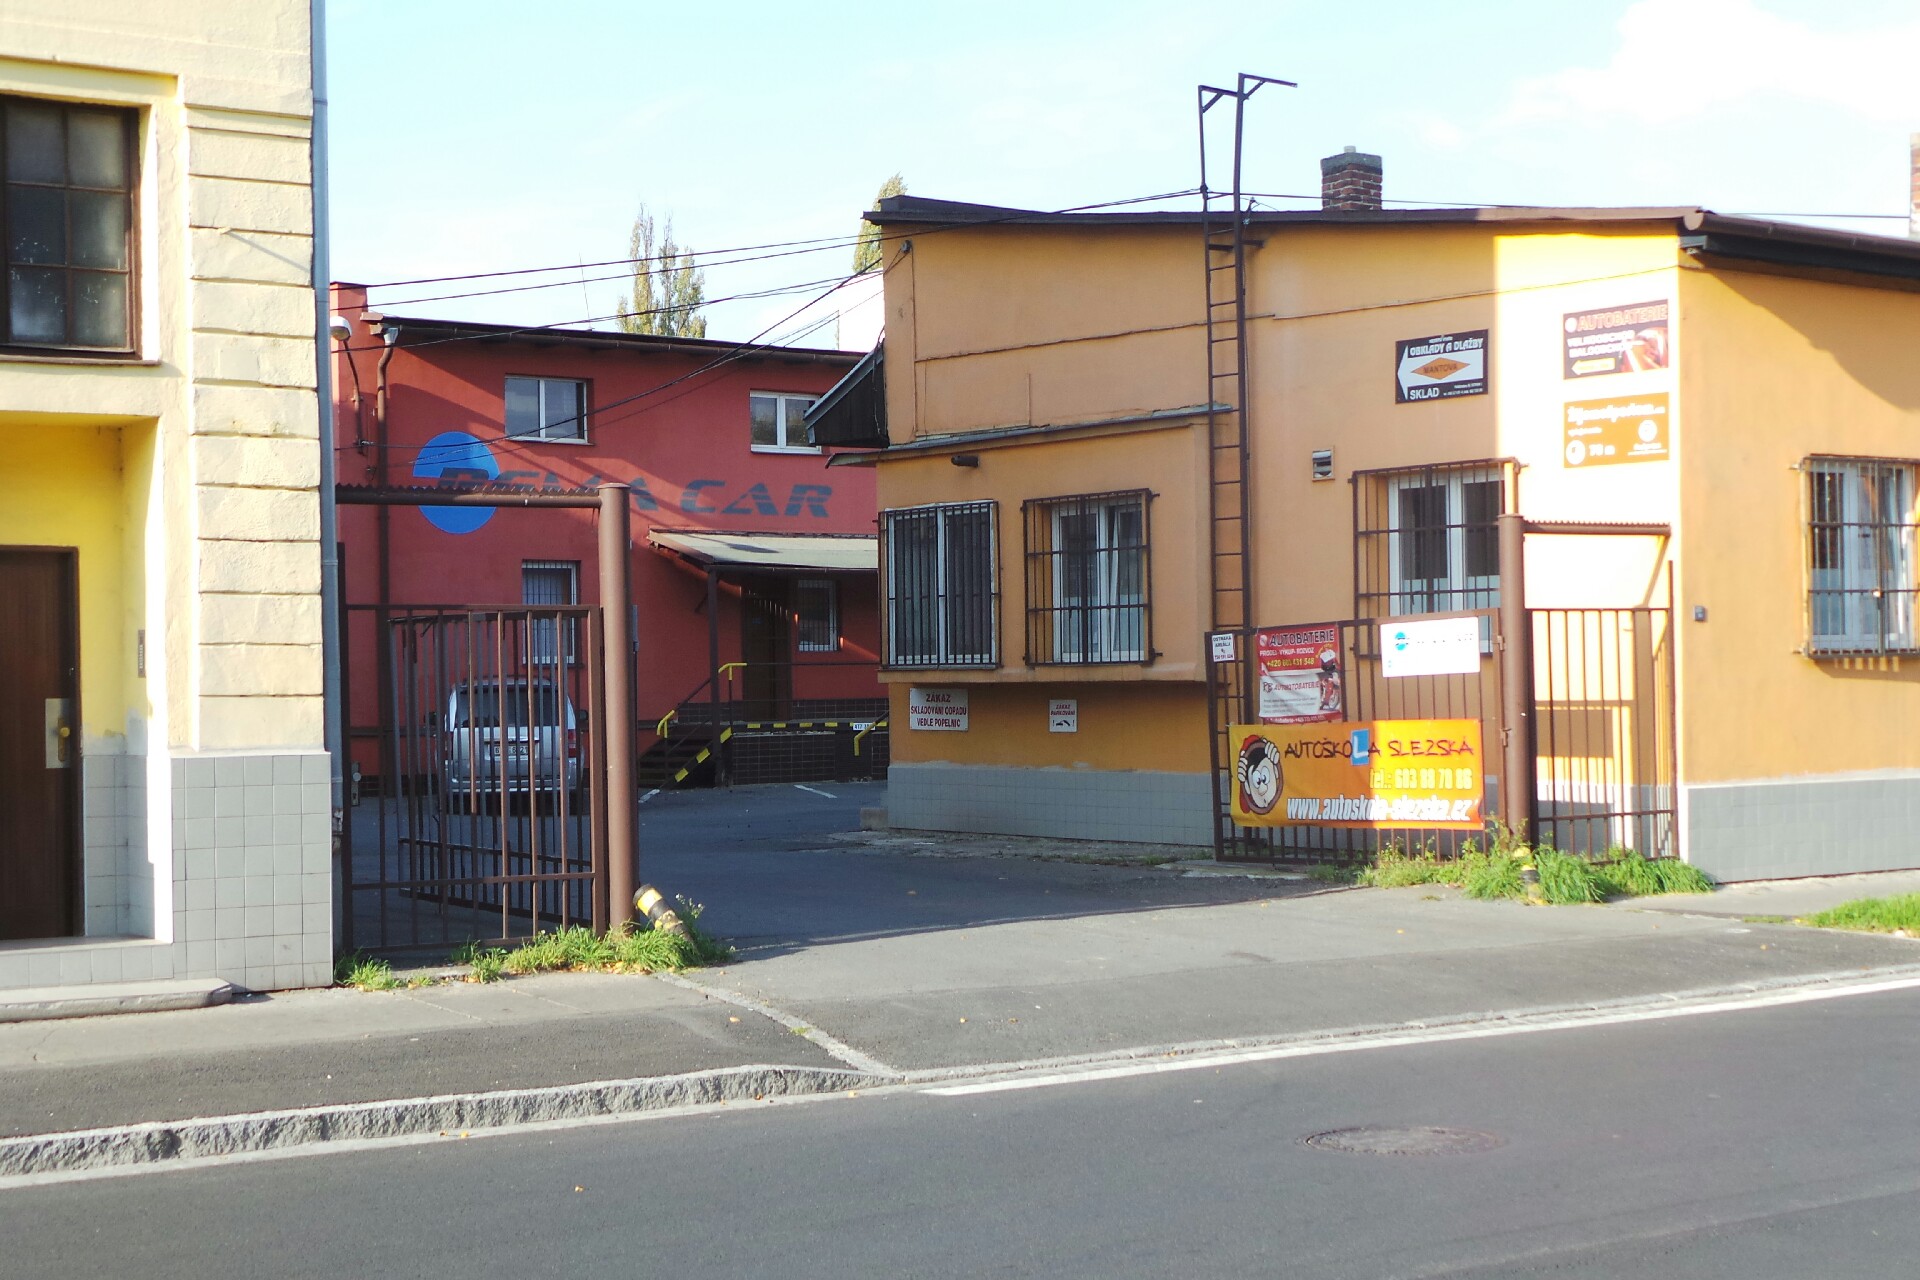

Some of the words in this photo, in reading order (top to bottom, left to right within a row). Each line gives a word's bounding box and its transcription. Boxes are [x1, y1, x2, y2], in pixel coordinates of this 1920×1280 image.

[1577, 304, 1667, 331] AUTOBATERIE
[1410, 343, 1444, 356] OBKLADY
[1446, 343, 1452, 352] A
[1454, 338, 1483, 350] DLAŽBY
[1424, 364, 1457, 374] MANTOVA
[1410, 388, 1439, 400] SKLAD
[681, 479, 832, 518] CAR
[1269, 629, 1335, 647] AUTOBATERIE
[926, 692, 951, 703] ZÁKAZ
[917, 718, 934, 727] VEDLE
[935, 718, 961, 728] POPELNIC
[1284, 732, 1381, 761] AUTOŠKOLA
[1394, 768, 1418, 789] 603
[1287, 794, 1471, 821] www.autoskola-slezska.cz
